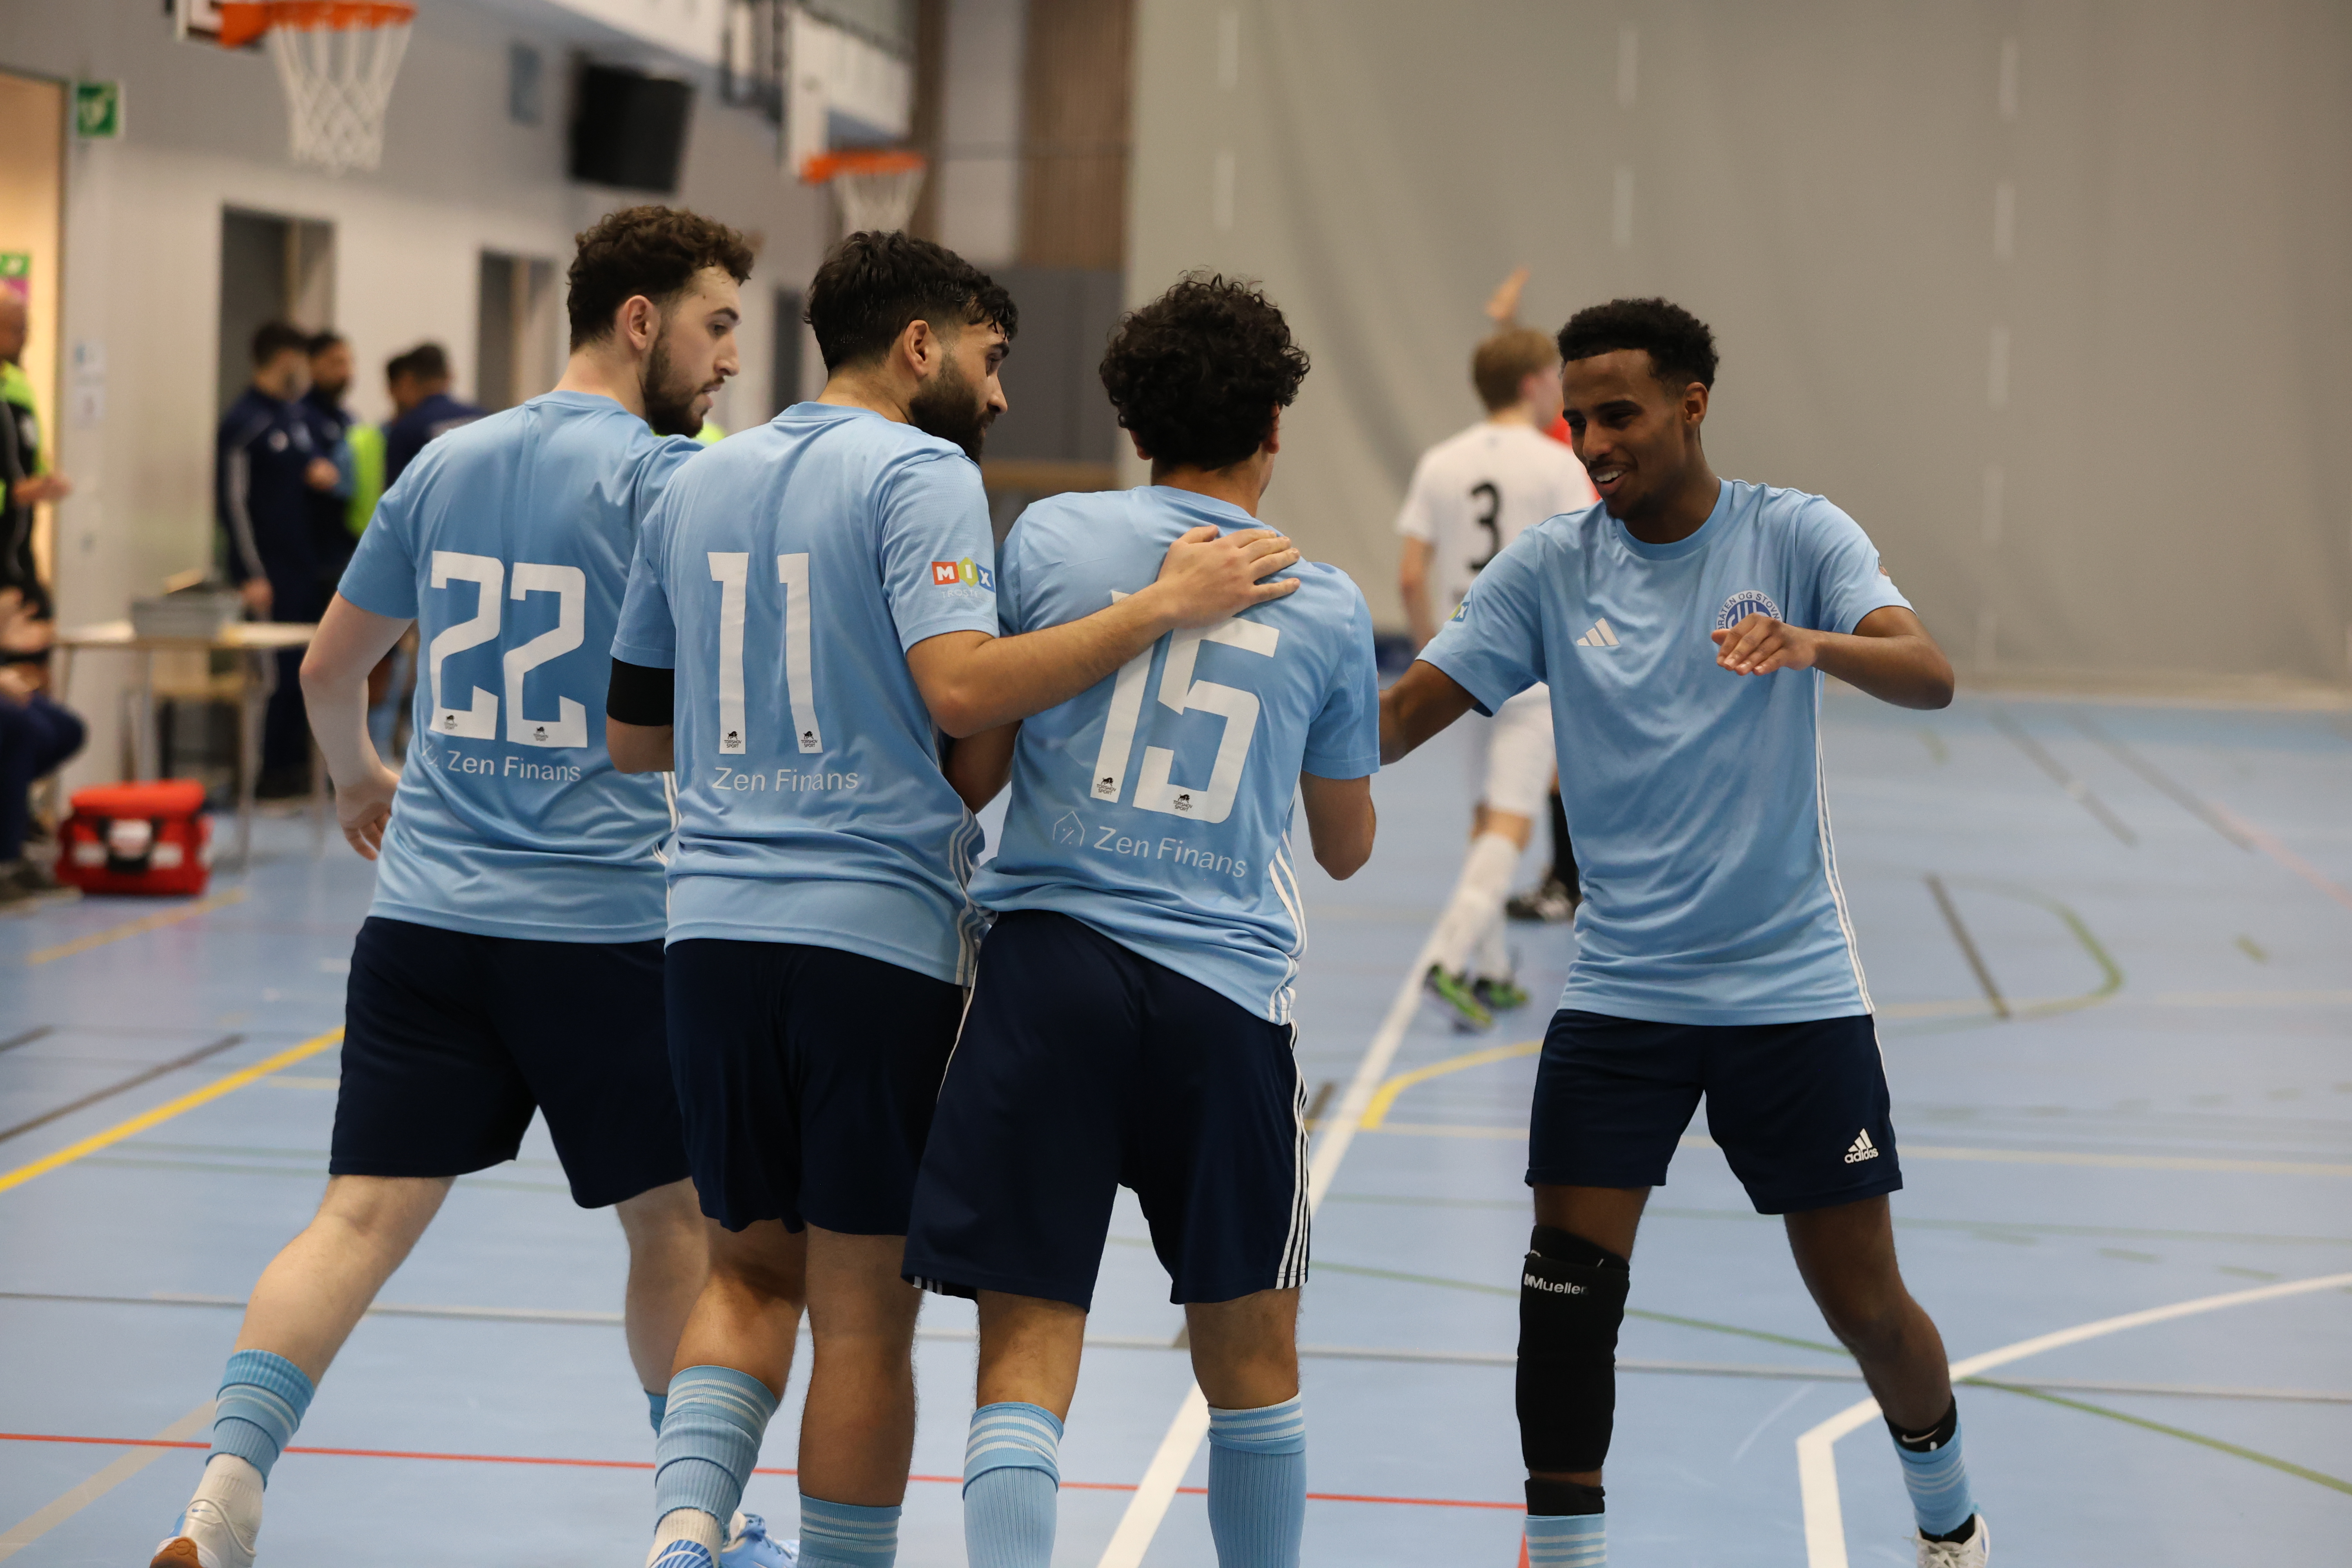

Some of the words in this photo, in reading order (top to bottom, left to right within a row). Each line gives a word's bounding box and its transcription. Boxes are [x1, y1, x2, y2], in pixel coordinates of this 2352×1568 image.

[1470, 482, 1501, 571] 3
[935, 564, 992, 588] MIX
[1738, 592, 1753, 601] OG
[1755, 593, 1780, 621] STOVN
[430, 550, 588, 748] 22
[707, 552, 823, 755] 11
[1090, 590, 1279, 824] 15
[447, 750, 494, 775] Zen
[504, 756, 581, 782] Finans
[712, 767, 766, 791] Zen
[775, 769, 858, 791] Finans
[1093, 826, 1148, 858] Zen
[1157, 837, 1247, 878] Finans
[1844, 1148, 1879, 1164] adidas
